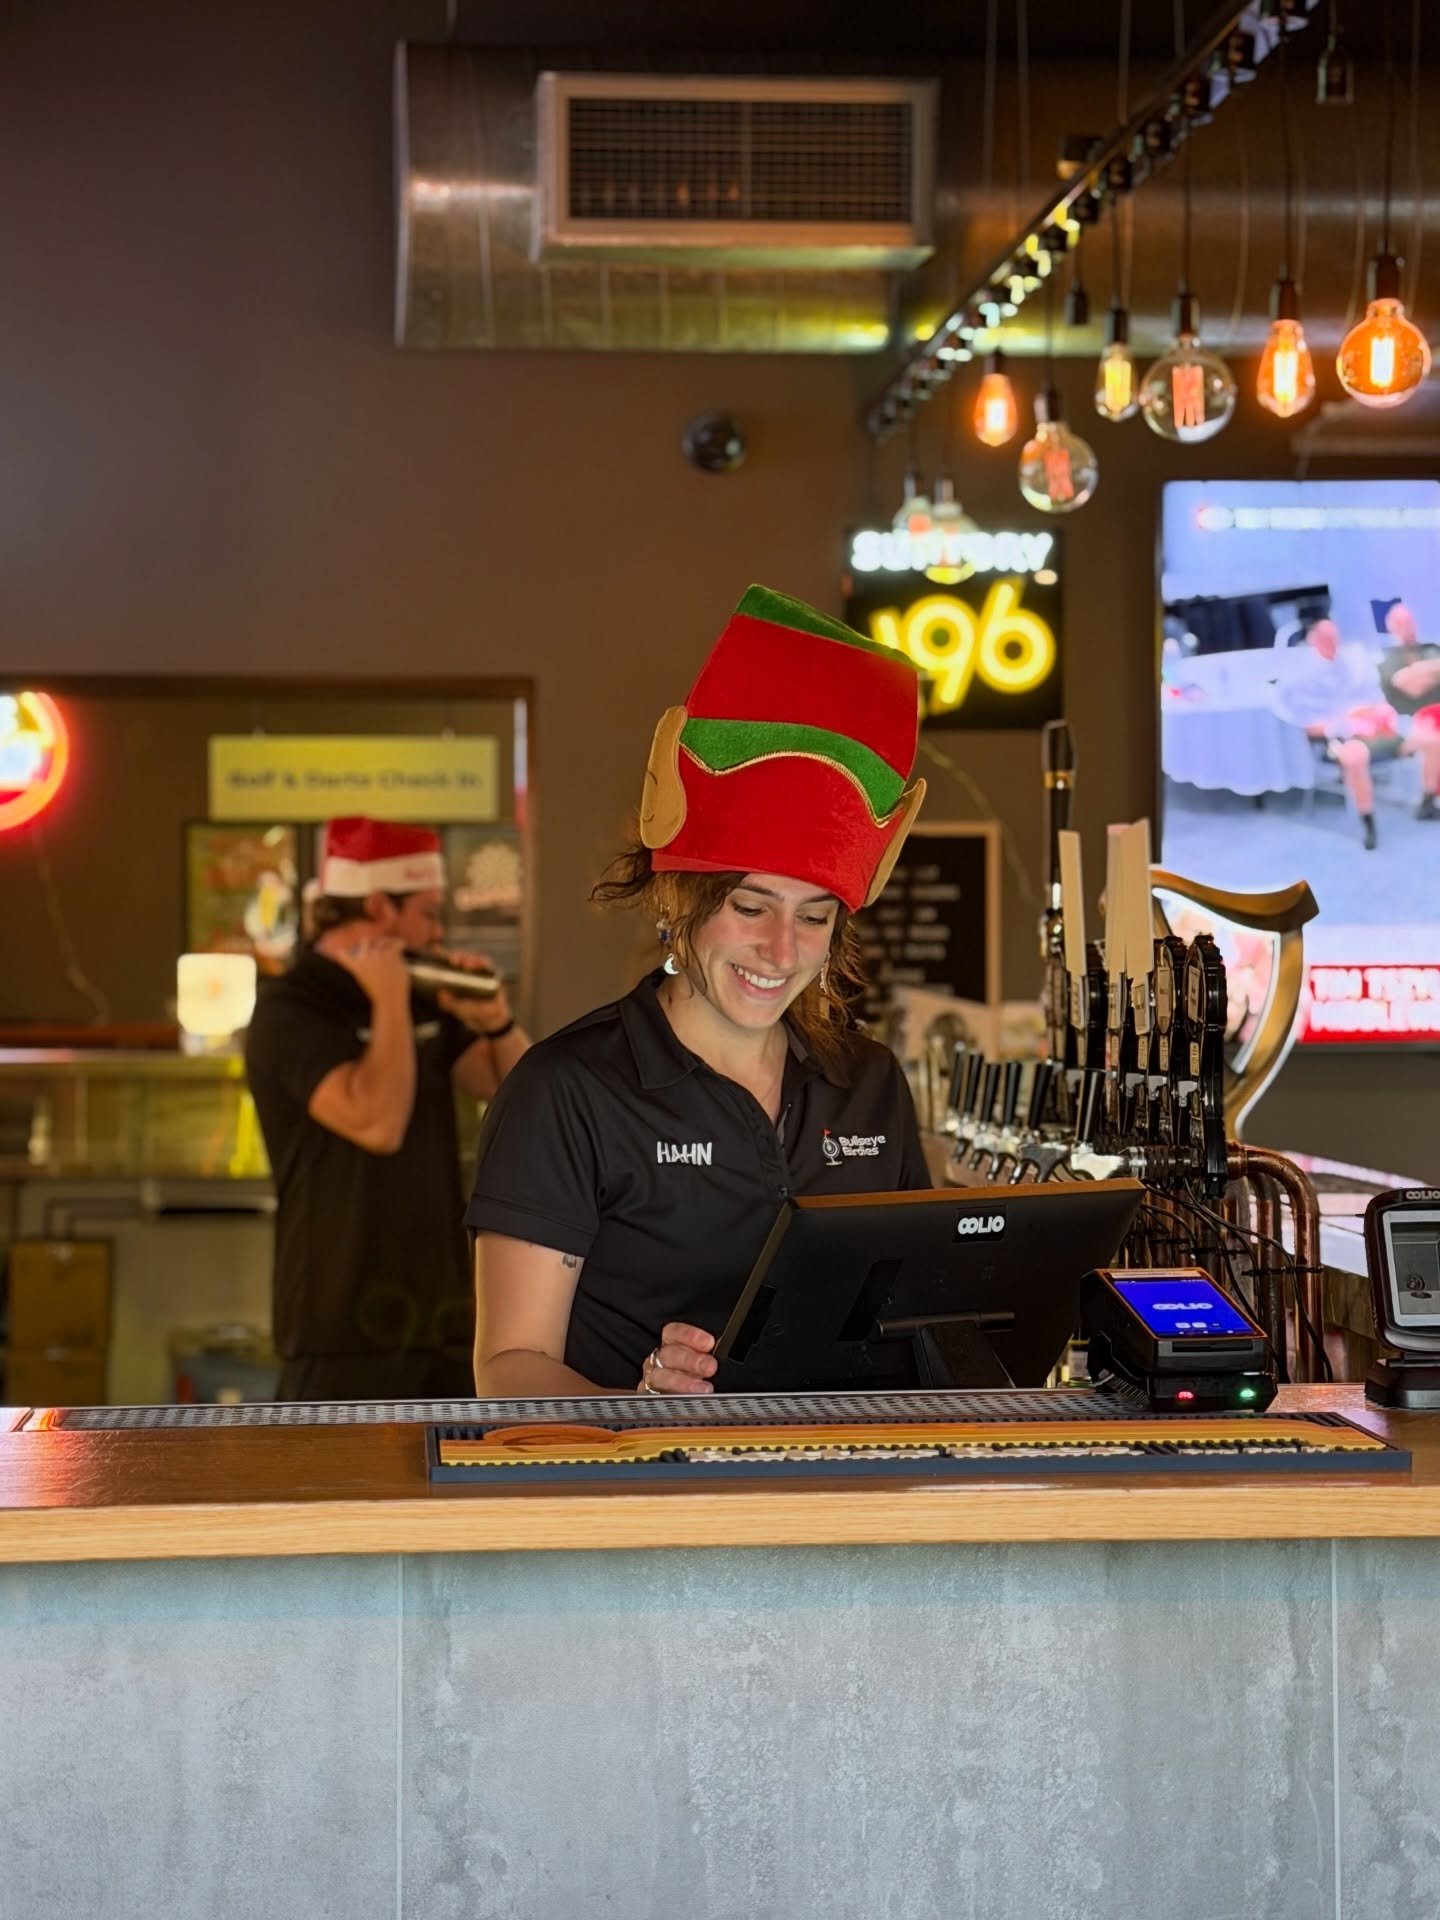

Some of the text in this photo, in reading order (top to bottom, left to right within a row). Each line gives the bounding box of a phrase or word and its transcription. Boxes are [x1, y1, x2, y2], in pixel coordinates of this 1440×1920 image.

[839, 1135, 887, 1148] Bullseye
[656, 1141, 713, 1166] HAHN
[957, 1215, 1005, 1235] OOLIO
